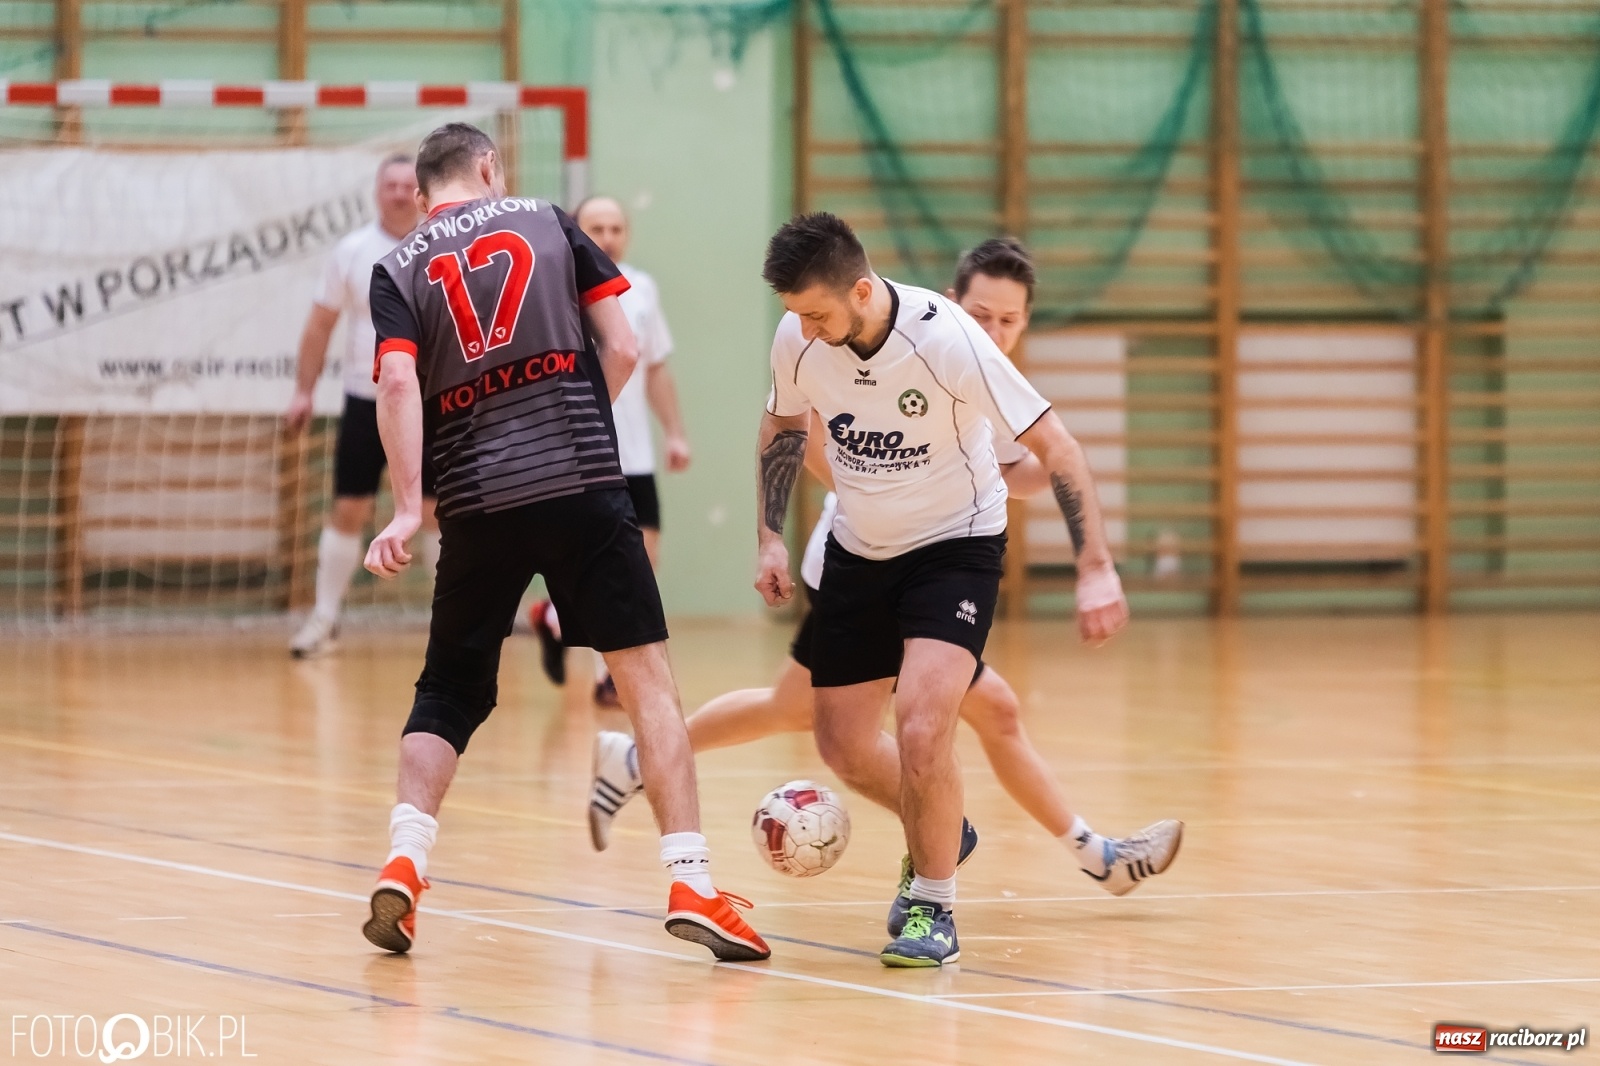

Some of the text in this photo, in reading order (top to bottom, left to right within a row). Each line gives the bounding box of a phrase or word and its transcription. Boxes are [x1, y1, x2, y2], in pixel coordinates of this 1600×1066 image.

[396, 233, 429, 268] LKS
[42, 277, 84, 327] W
[425, 229, 535, 363] 17
[854, 377, 877, 387] erima
